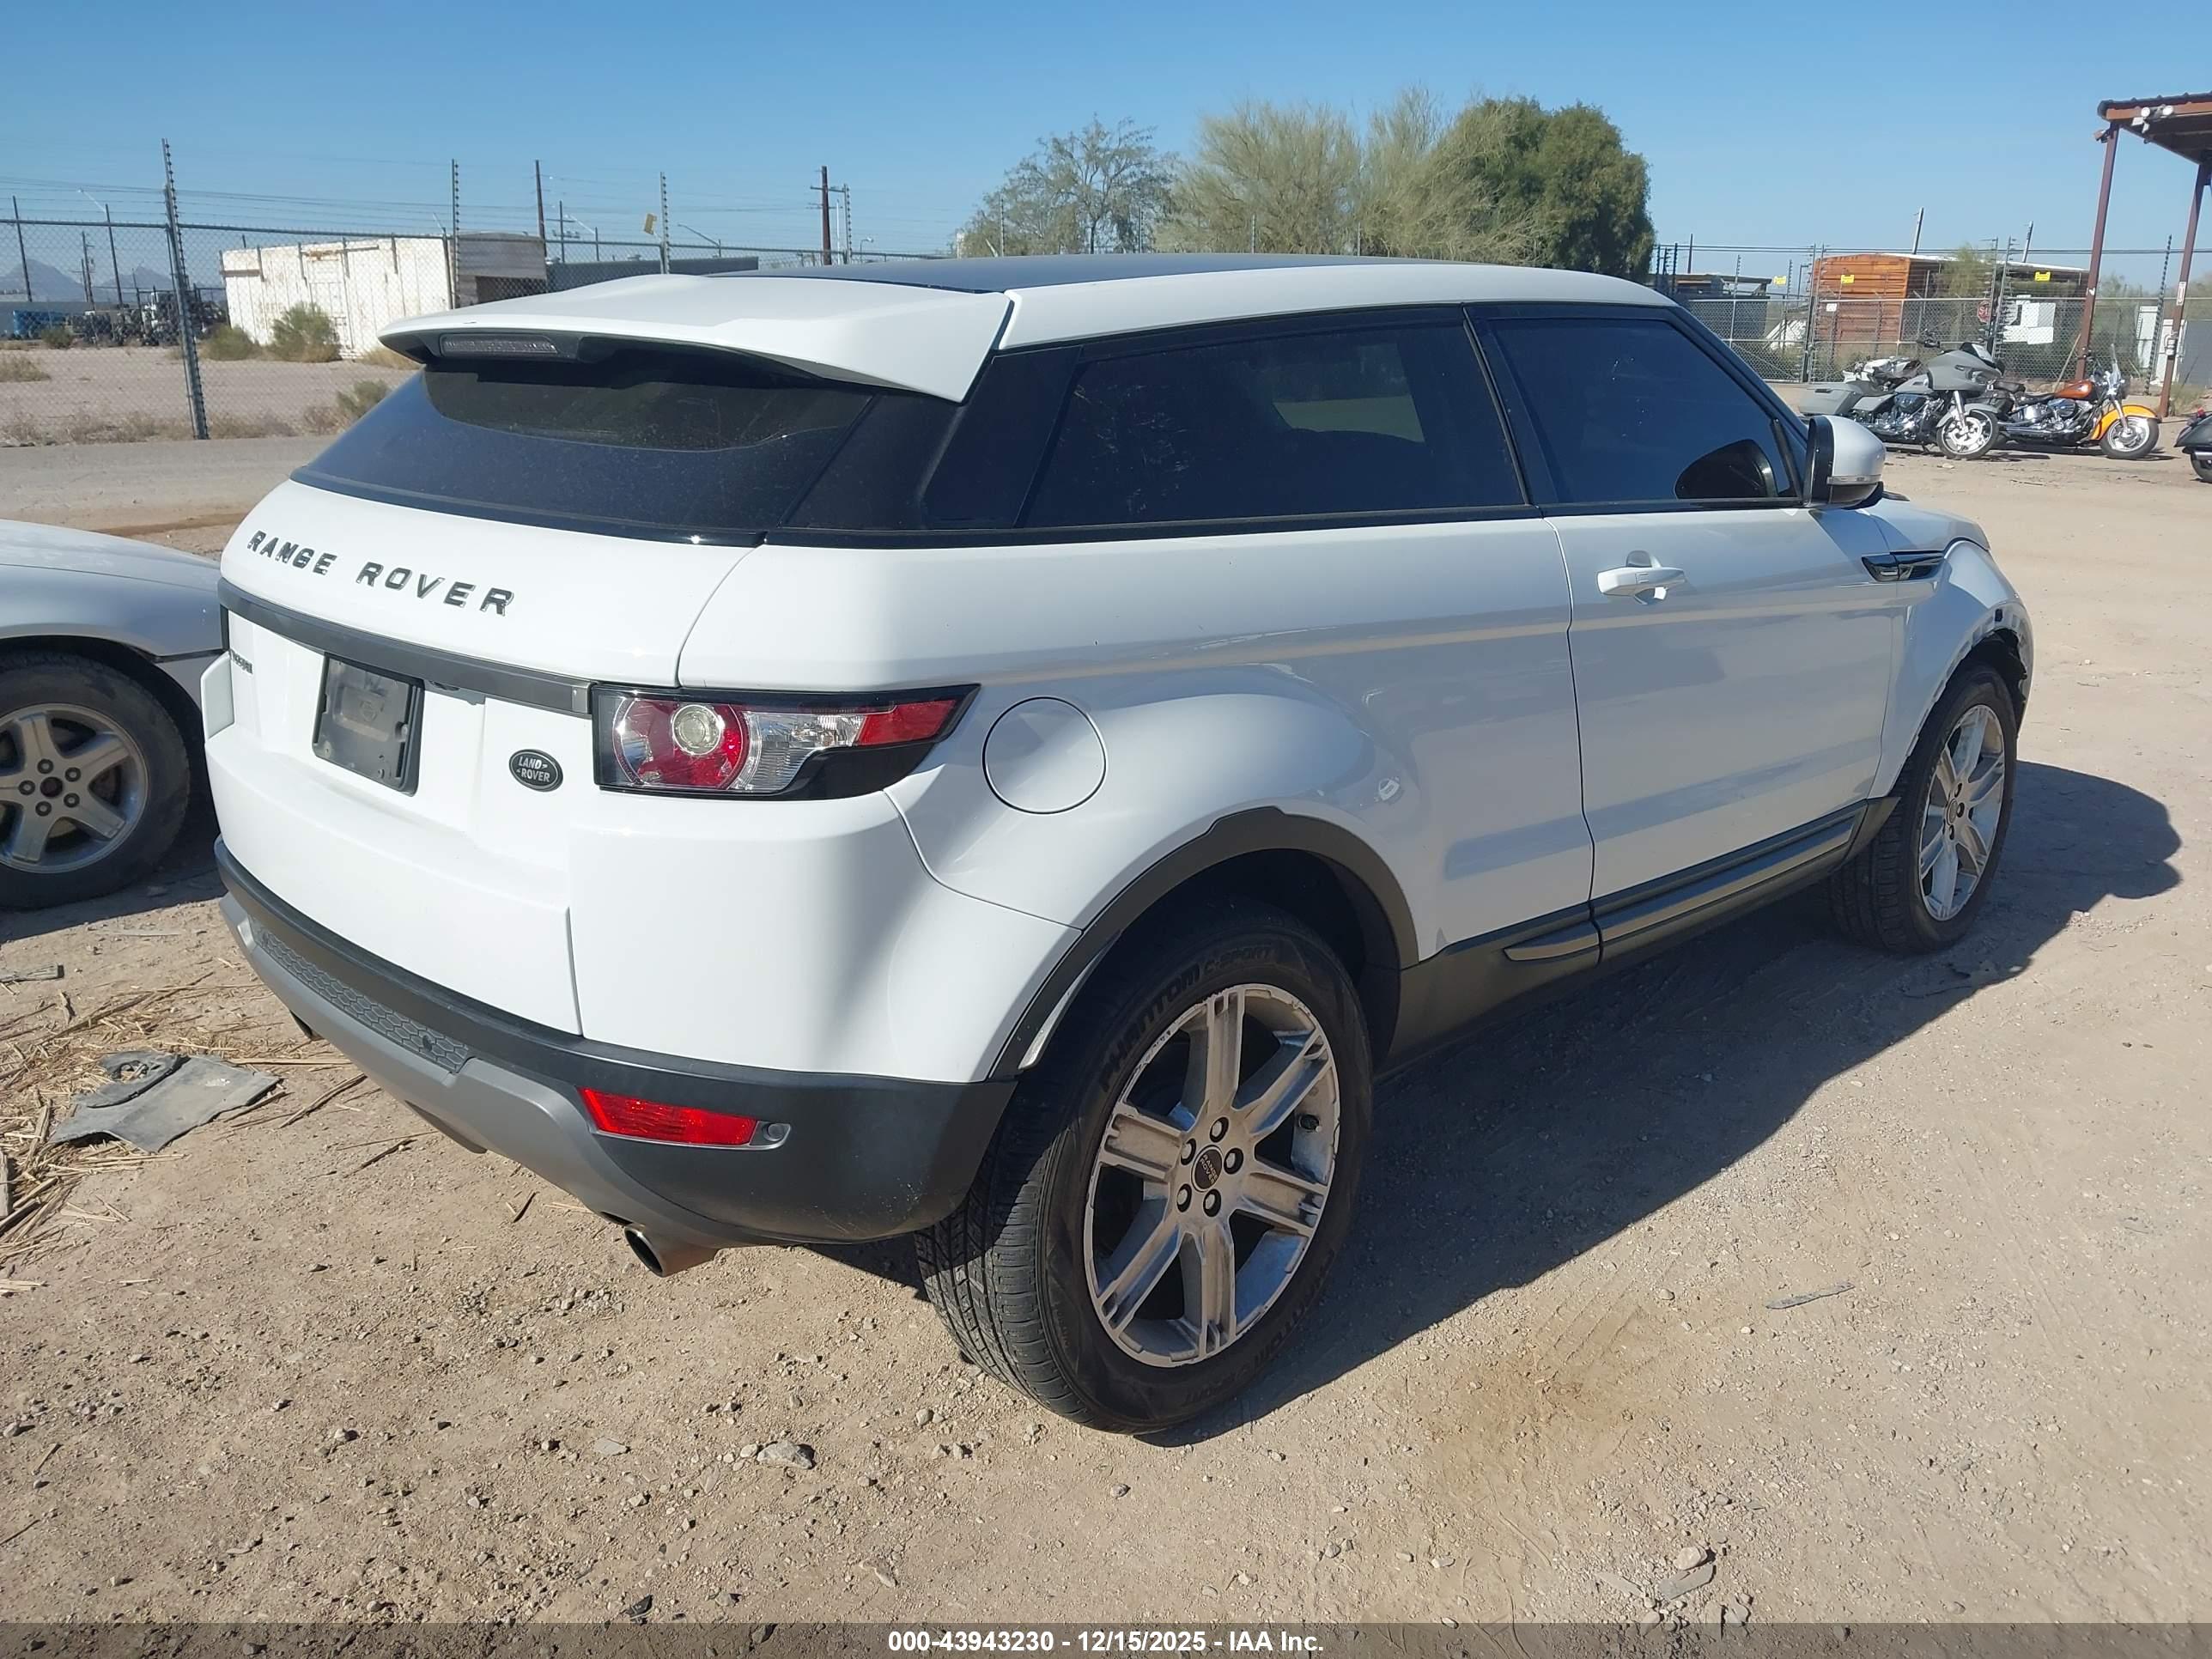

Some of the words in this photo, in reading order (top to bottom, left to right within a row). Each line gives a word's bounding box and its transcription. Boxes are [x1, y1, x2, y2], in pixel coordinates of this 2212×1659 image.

[246, 530, 337, 576] RANGE
[356, 561, 514, 617] ROVER
[519, 756, 543, 769] LAND
[520, 768, 550, 783] ROVER
[1098, 962, 1200, 1093] PHANTOM
[1199, 1158, 1215, 1184] ROVER
[1202, 1154, 1218, 1181] RANGE
